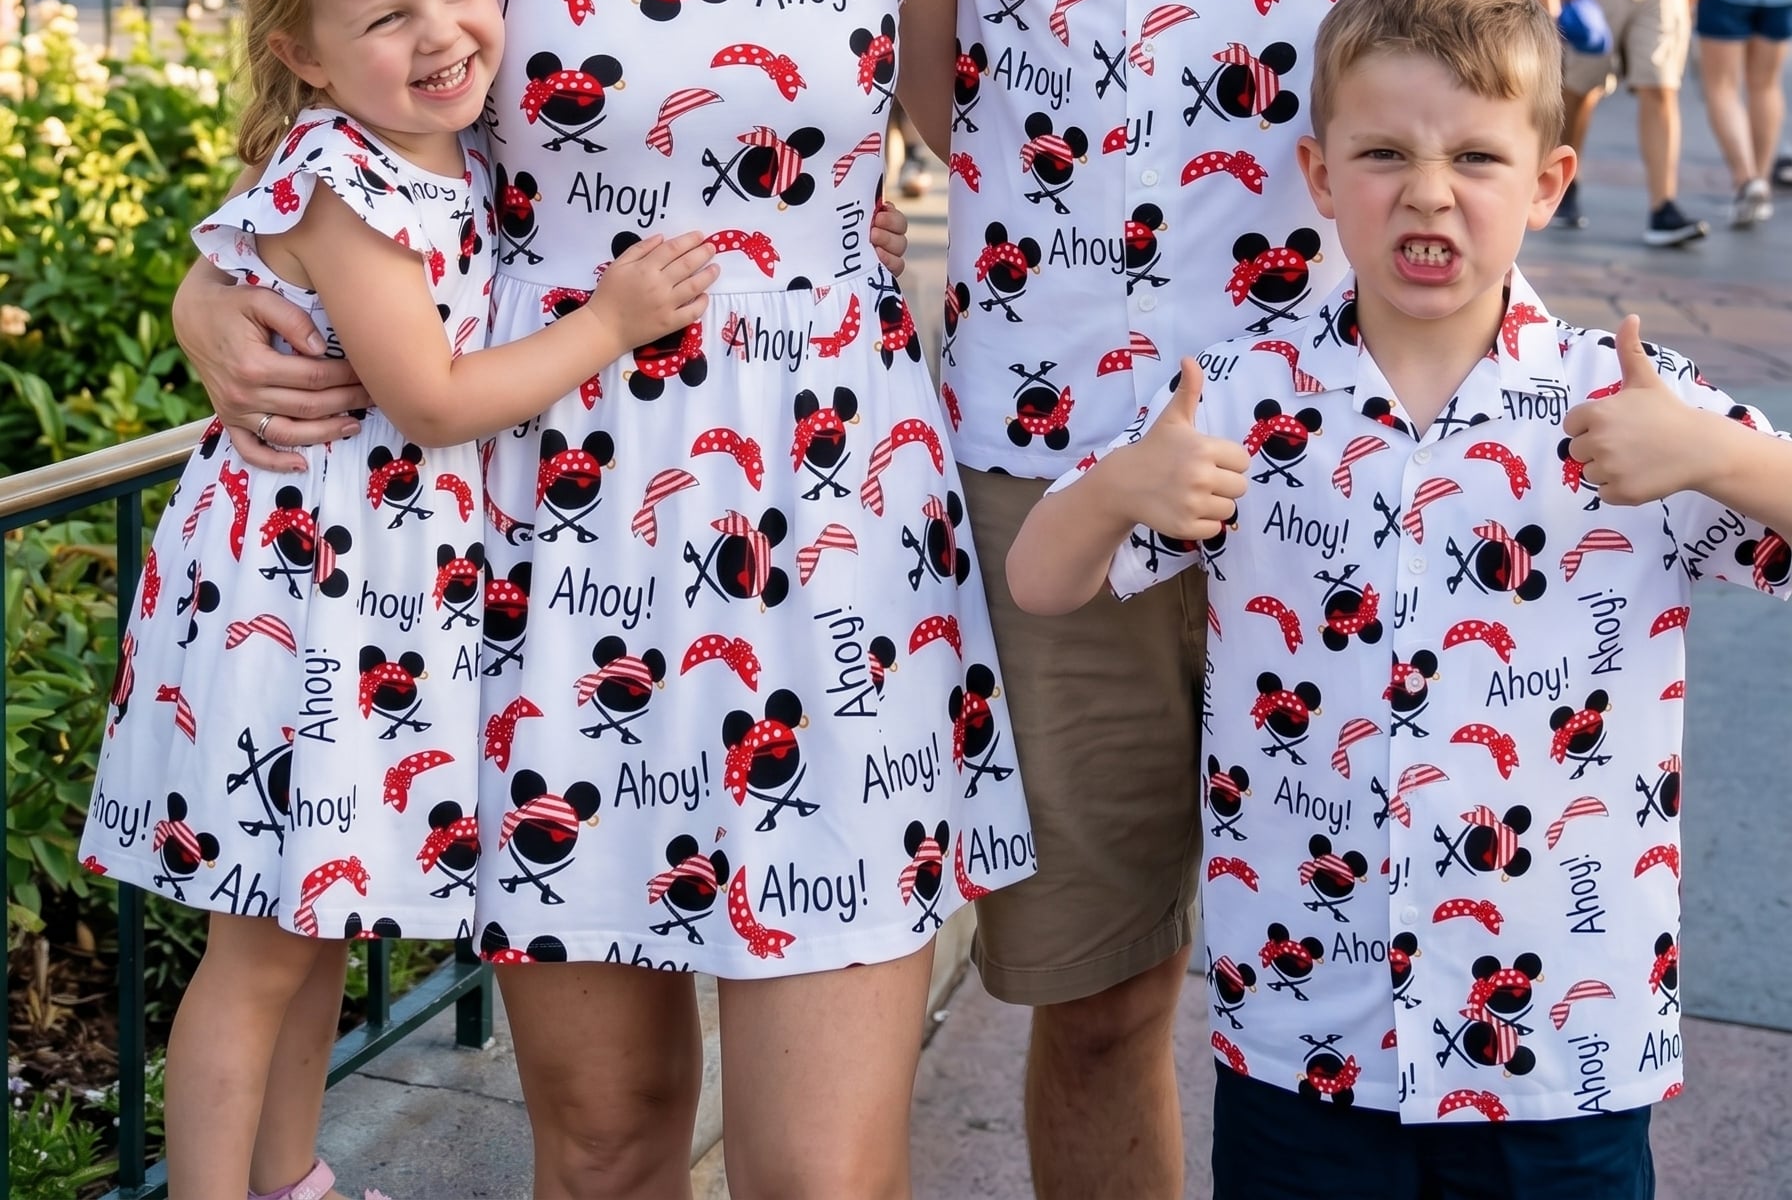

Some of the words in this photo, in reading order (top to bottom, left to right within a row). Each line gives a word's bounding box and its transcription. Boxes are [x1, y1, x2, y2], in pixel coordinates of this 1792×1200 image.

[993, 46, 1072, 111] Ahoy!
[566, 171, 671, 229] Ahoy!
[726, 316, 812, 373] Ahoy!
[1262, 500, 1350, 560] Ahoy!
[548, 566, 656, 630] Ahoy!
[813, 605, 877, 717] Ahoy!
[1577, 588, 1627, 675] Ahoy!
[297, 648, 341, 743] Ahoy!
[1485, 656, 1570, 708] Ahoy!
[614, 750, 710, 812] Ahoy!
[863, 732, 941, 804] Ahoy!
[94, 792, 152, 848] hoy!
[1273, 776, 1352, 836] Ahoy!
[758, 858, 868, 923] Ahoy!
[1559, 854, 1605, 933] Ahoy!
[1567, 1033, 1612, 1115] Ahoy!
